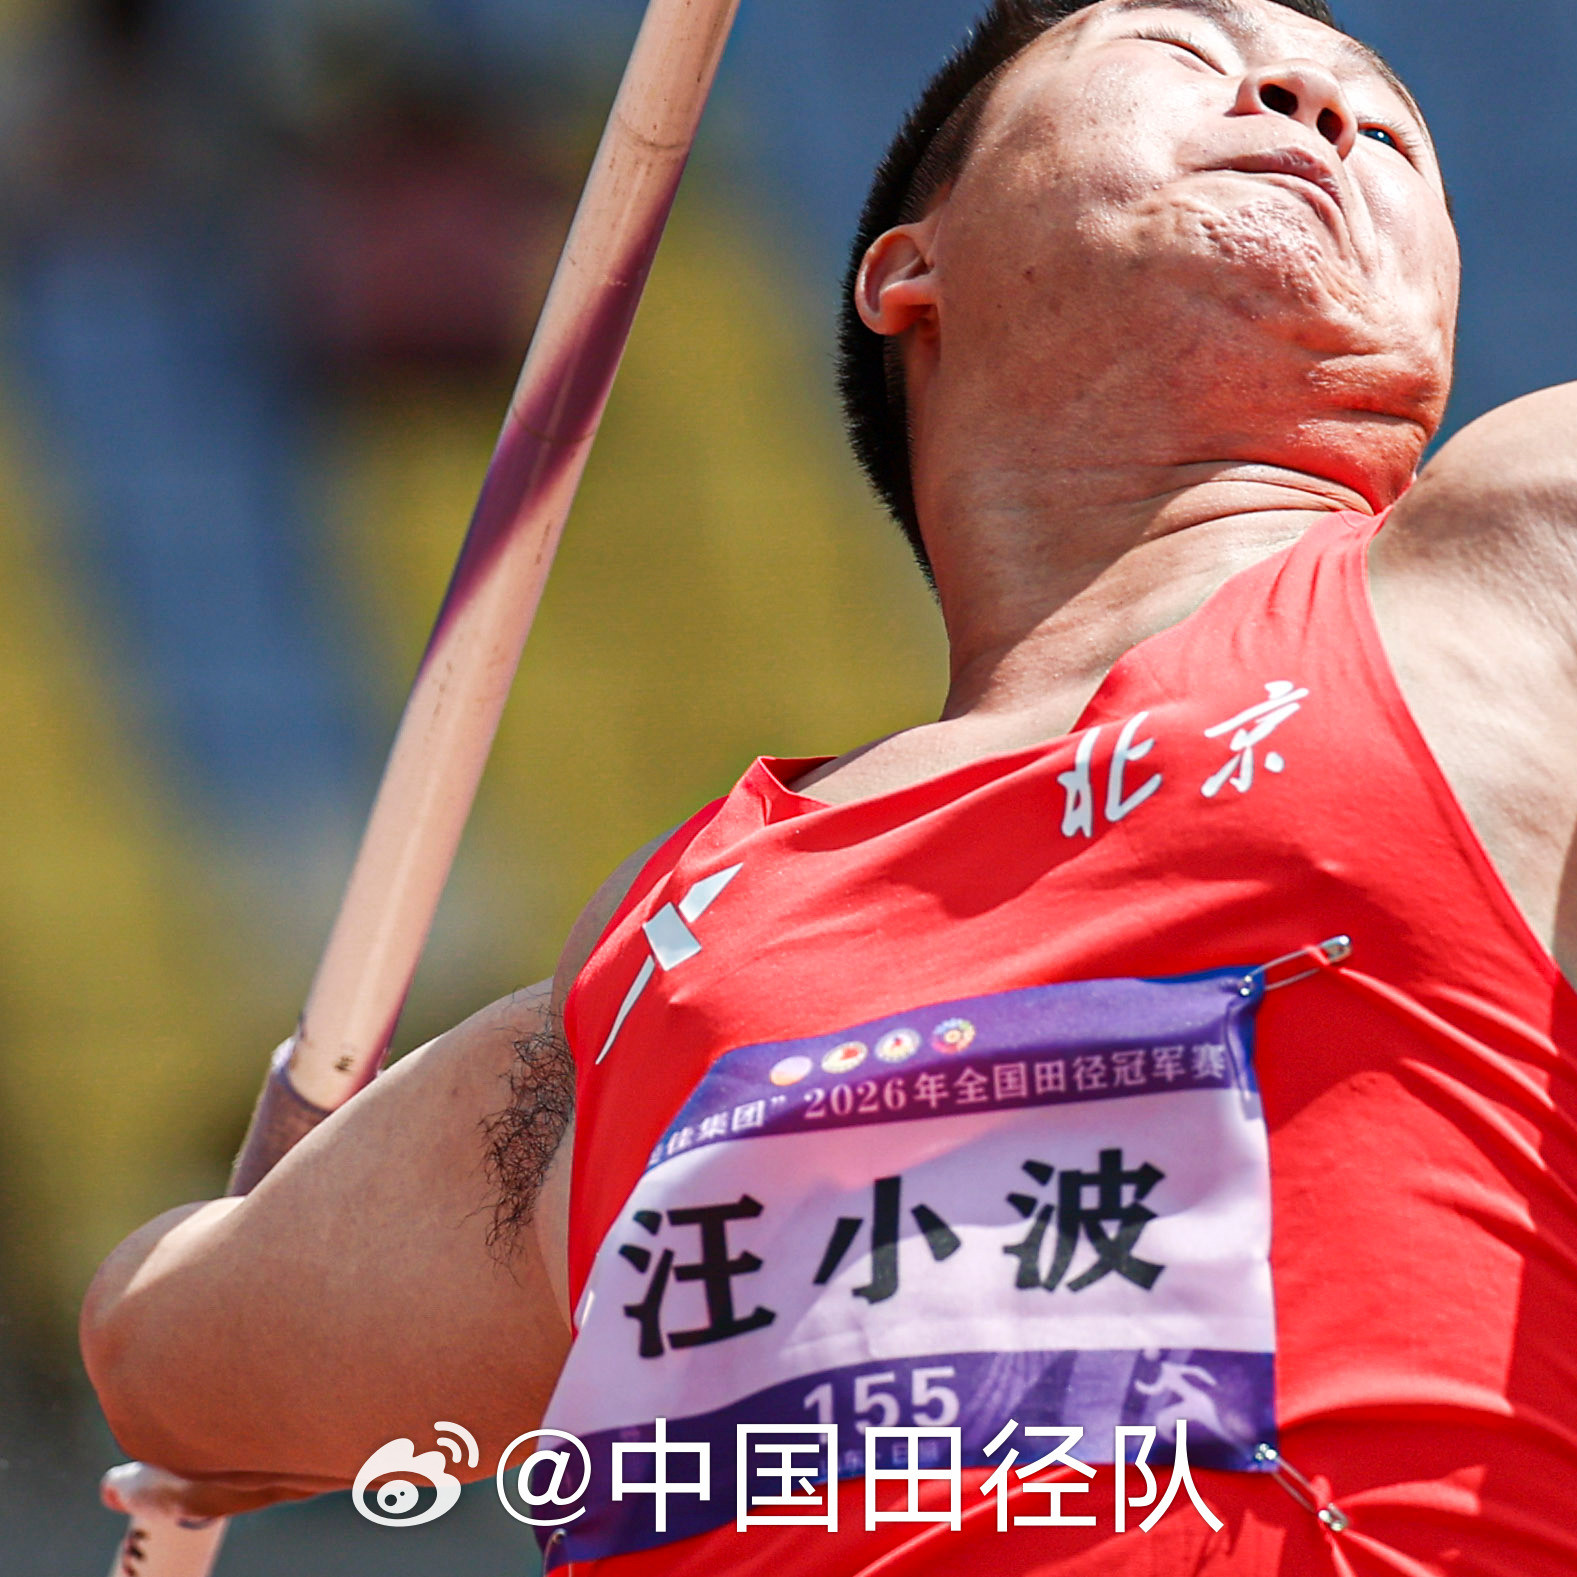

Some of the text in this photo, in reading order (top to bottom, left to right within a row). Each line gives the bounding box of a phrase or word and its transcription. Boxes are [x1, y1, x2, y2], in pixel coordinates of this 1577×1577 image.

[1057, 679, 1309, 838] 北京
[618, 1147, 1167, 1359] 汪小波
[803, 1365, 960, 1445] 155
